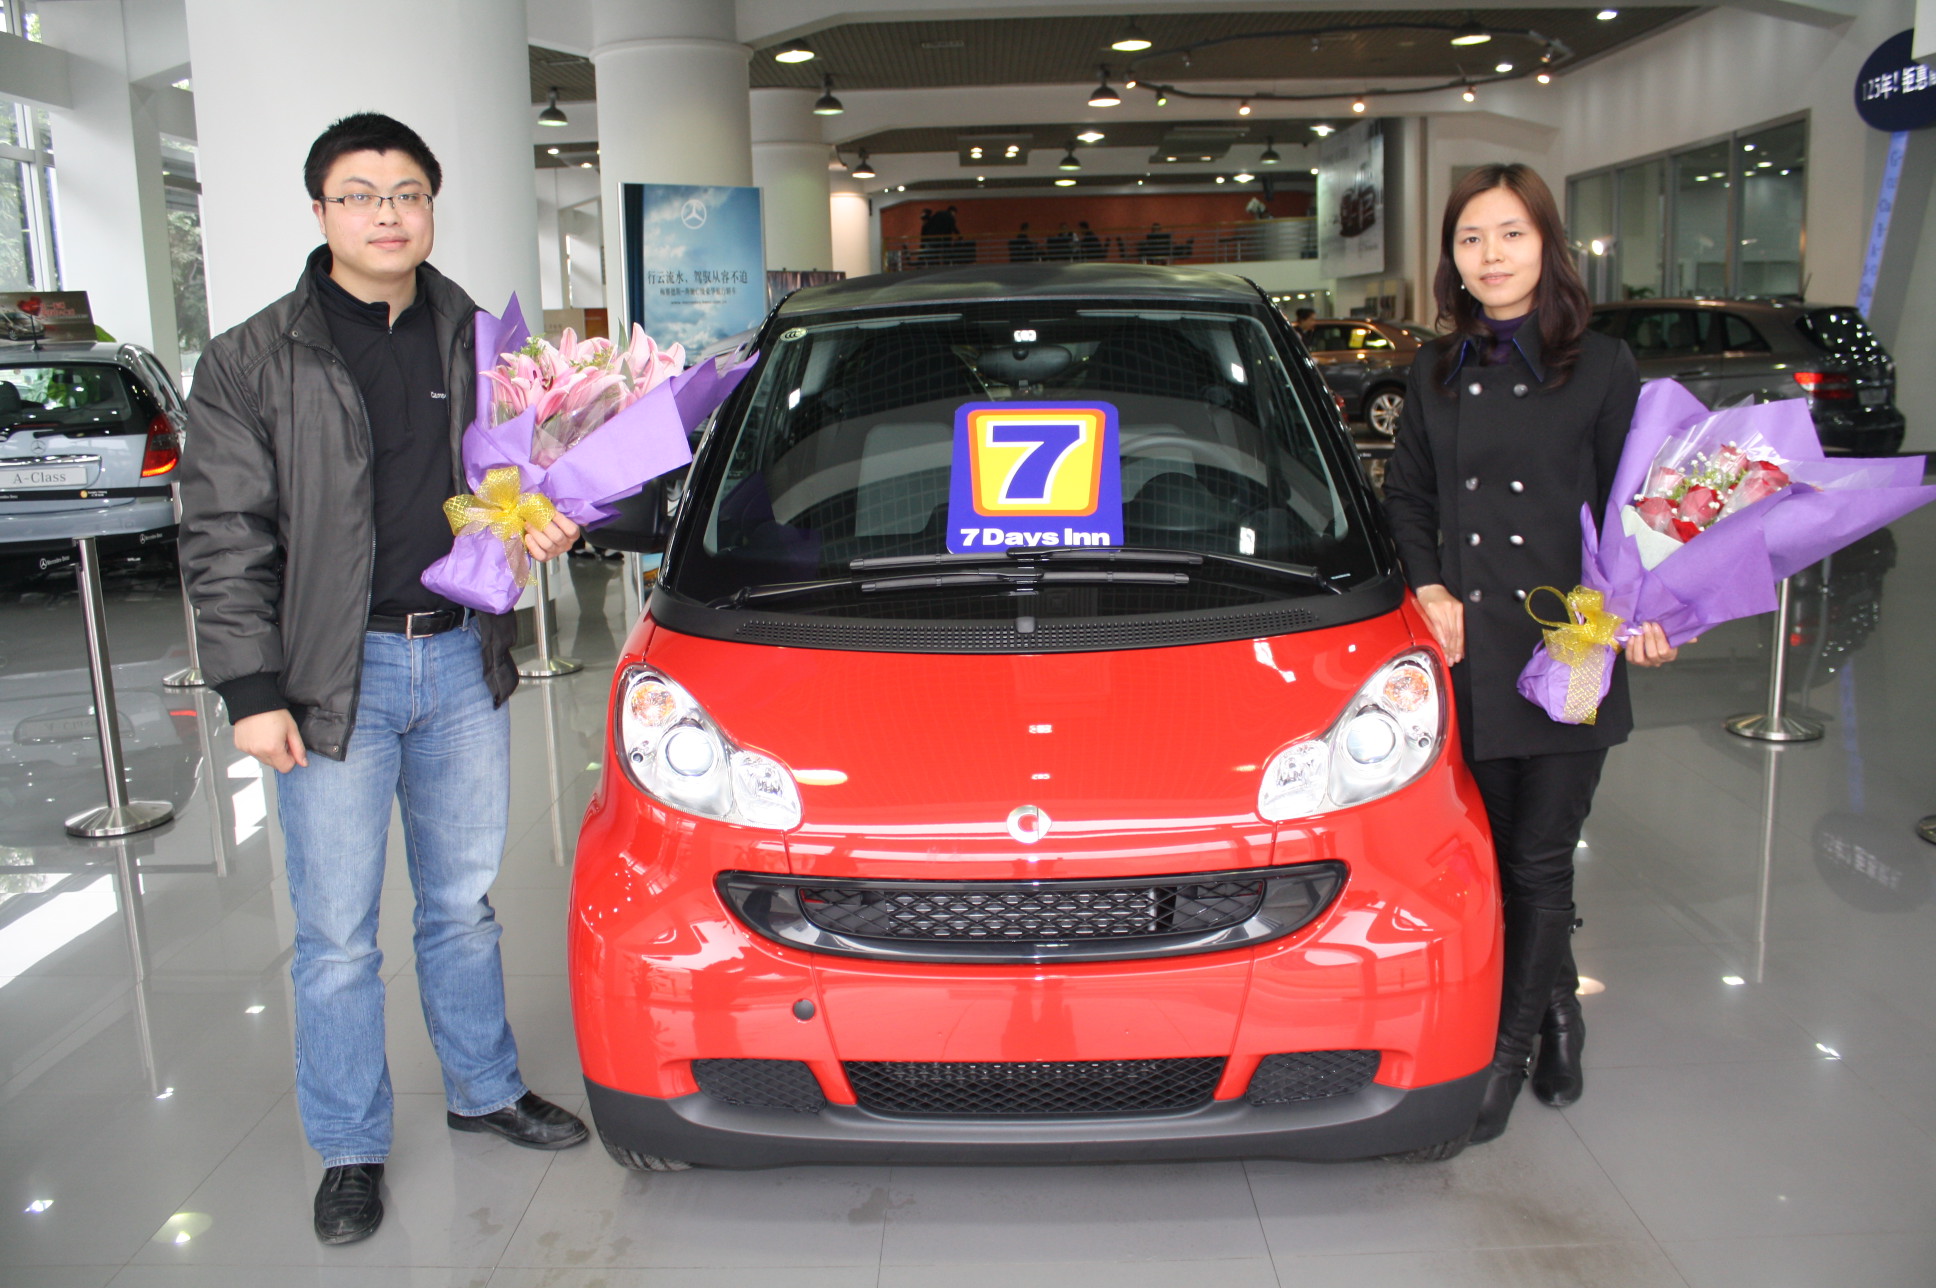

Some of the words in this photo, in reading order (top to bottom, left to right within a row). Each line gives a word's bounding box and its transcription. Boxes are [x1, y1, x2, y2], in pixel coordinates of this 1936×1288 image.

[986, 420, 1087, 504] 7
[13, 472, 66, 484] A-Class
[960, 528, 980, 547] 7
[982, 528, 1060, 547] Days
[1064, 528, 1111, 546] Inn
